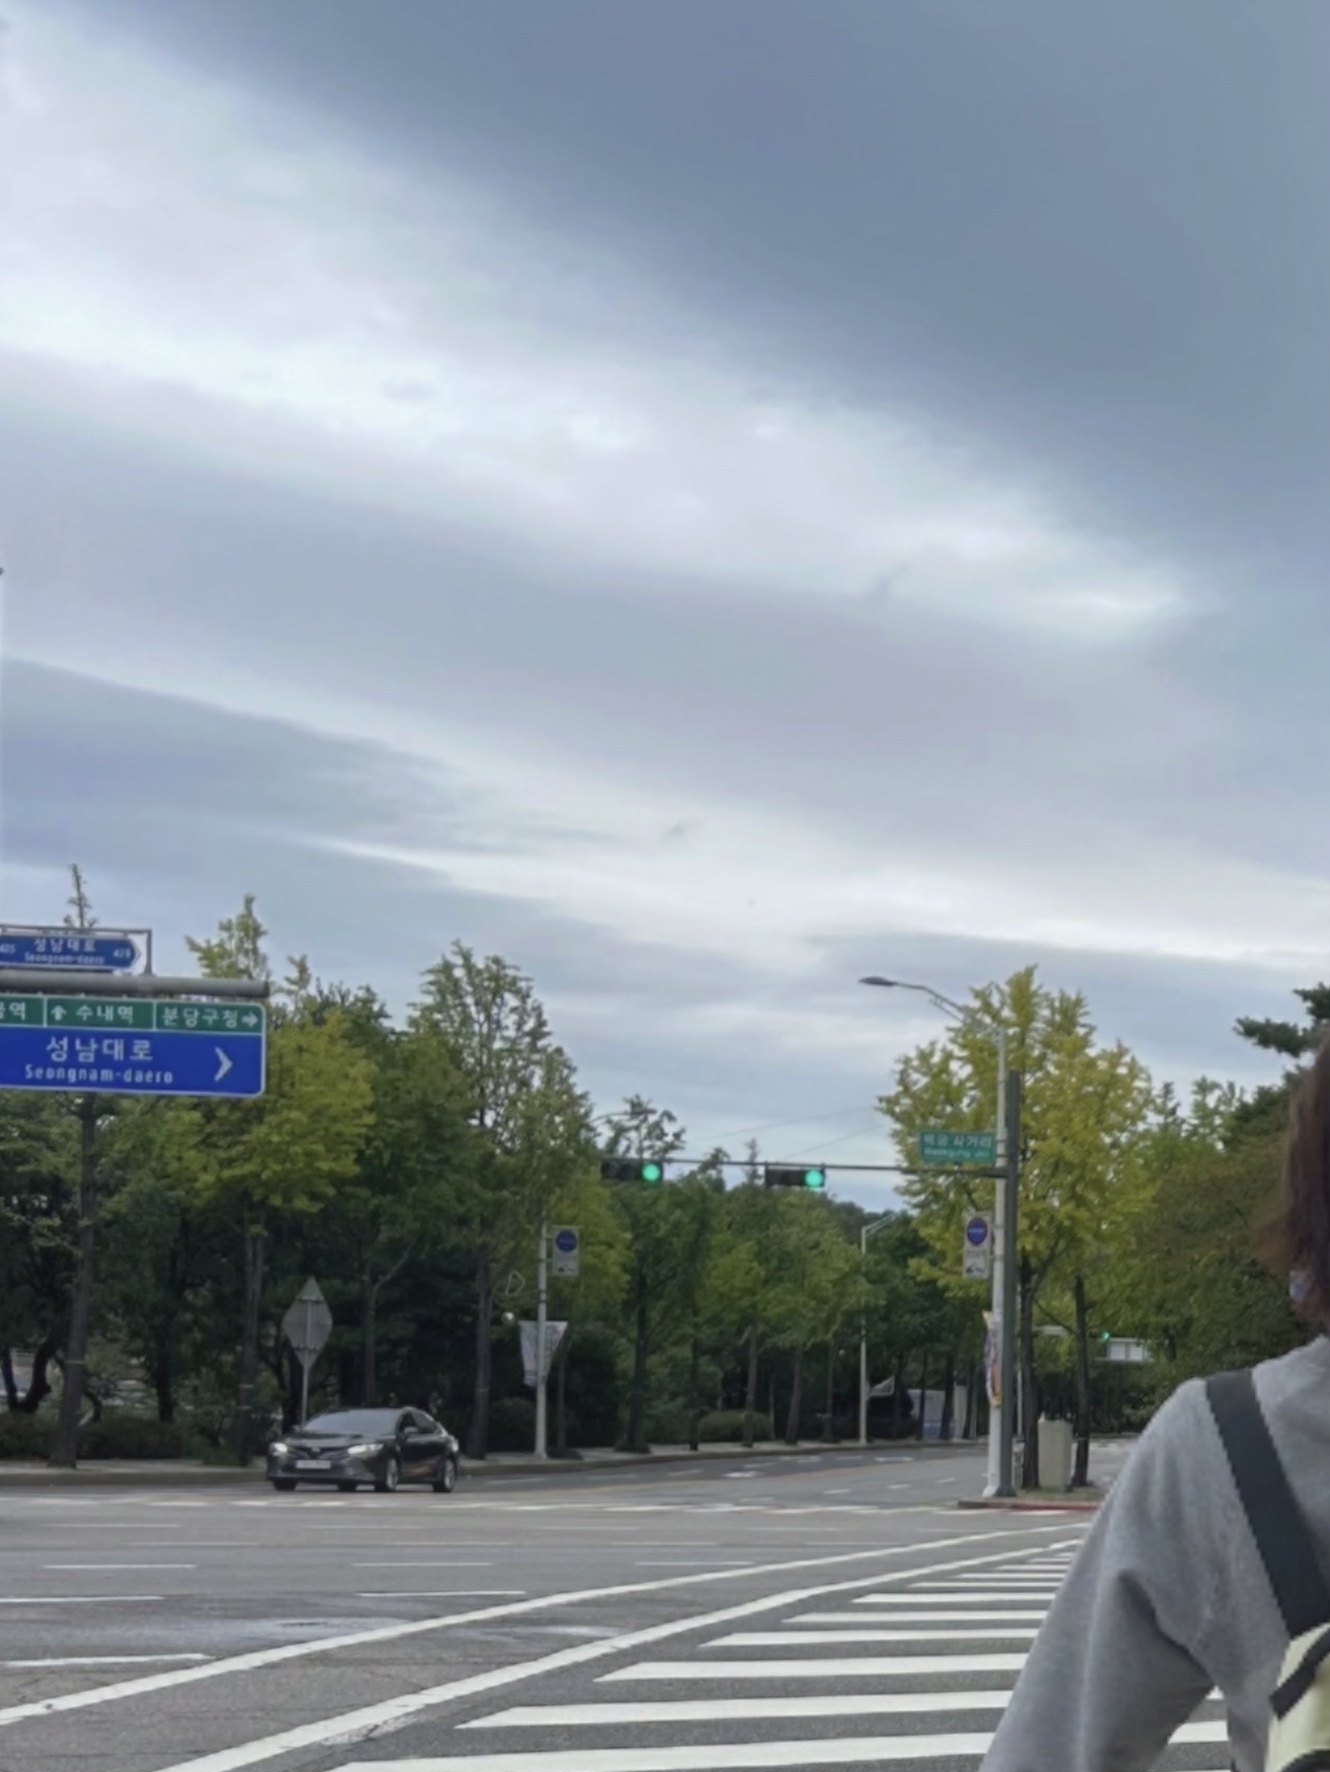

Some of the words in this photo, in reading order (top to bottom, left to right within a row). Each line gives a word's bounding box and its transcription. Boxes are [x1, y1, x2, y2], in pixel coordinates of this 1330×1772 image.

[35, 937, 97, 953] 성남대로
[76, 1004, 135, 1025] 수내역
[162, 1007, 239, 1029] 분당구청
[47, 1036, 154, 1064] 성남대로
[25, 1064, 174, 1083] Seongnam-daero
